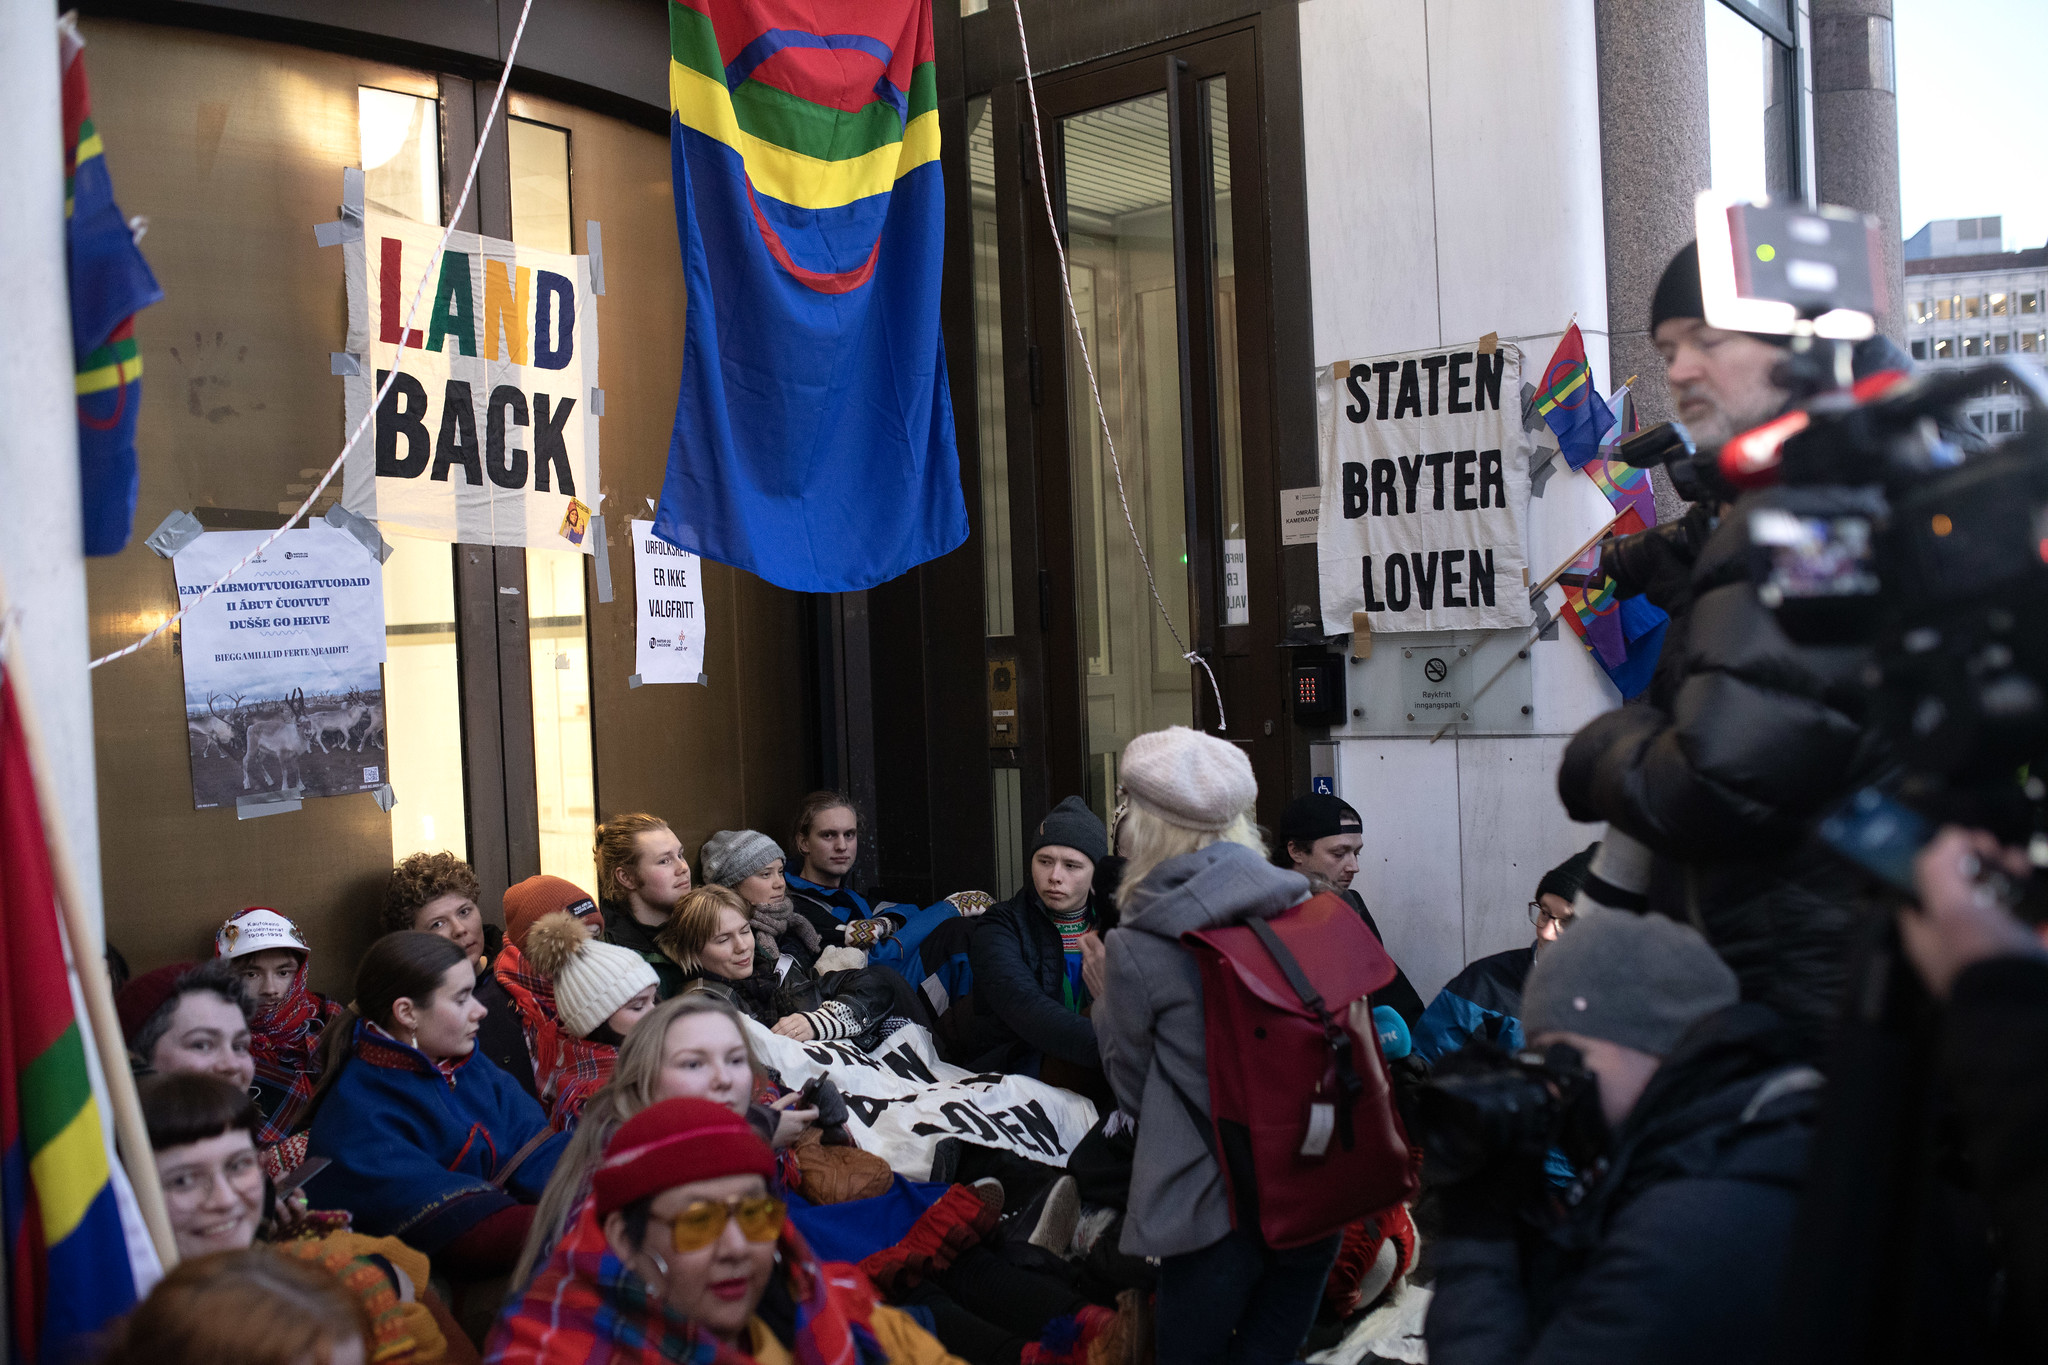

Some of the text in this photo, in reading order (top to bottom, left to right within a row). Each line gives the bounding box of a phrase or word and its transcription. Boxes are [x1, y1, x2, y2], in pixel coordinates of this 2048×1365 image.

[380, 236, 576, 371] LAND
[1345, 348, 1505, 424] STATEN
[375, 369, 577, 497] BACK
[1342, 448, 1507, 520] BRYTER
[654, 567, 687, 588] ER IKKE
[1362, 548, 1497, 613] LOVEN
[226, 596, 331, 612] II ÁBUT ČUOVVUT
[648, 599, 694, 619] VALGFRITT
[229, 615, 331, 630] DUŠŠE GO HEIVE
[214, 649, 283, 662] BIEGGAMILLUID
[283, 647, 310, 658] FERTE
[1422, 691, 1452, 699] Røykfritt
[1414, 701, 1461, 710] inngangsparti
